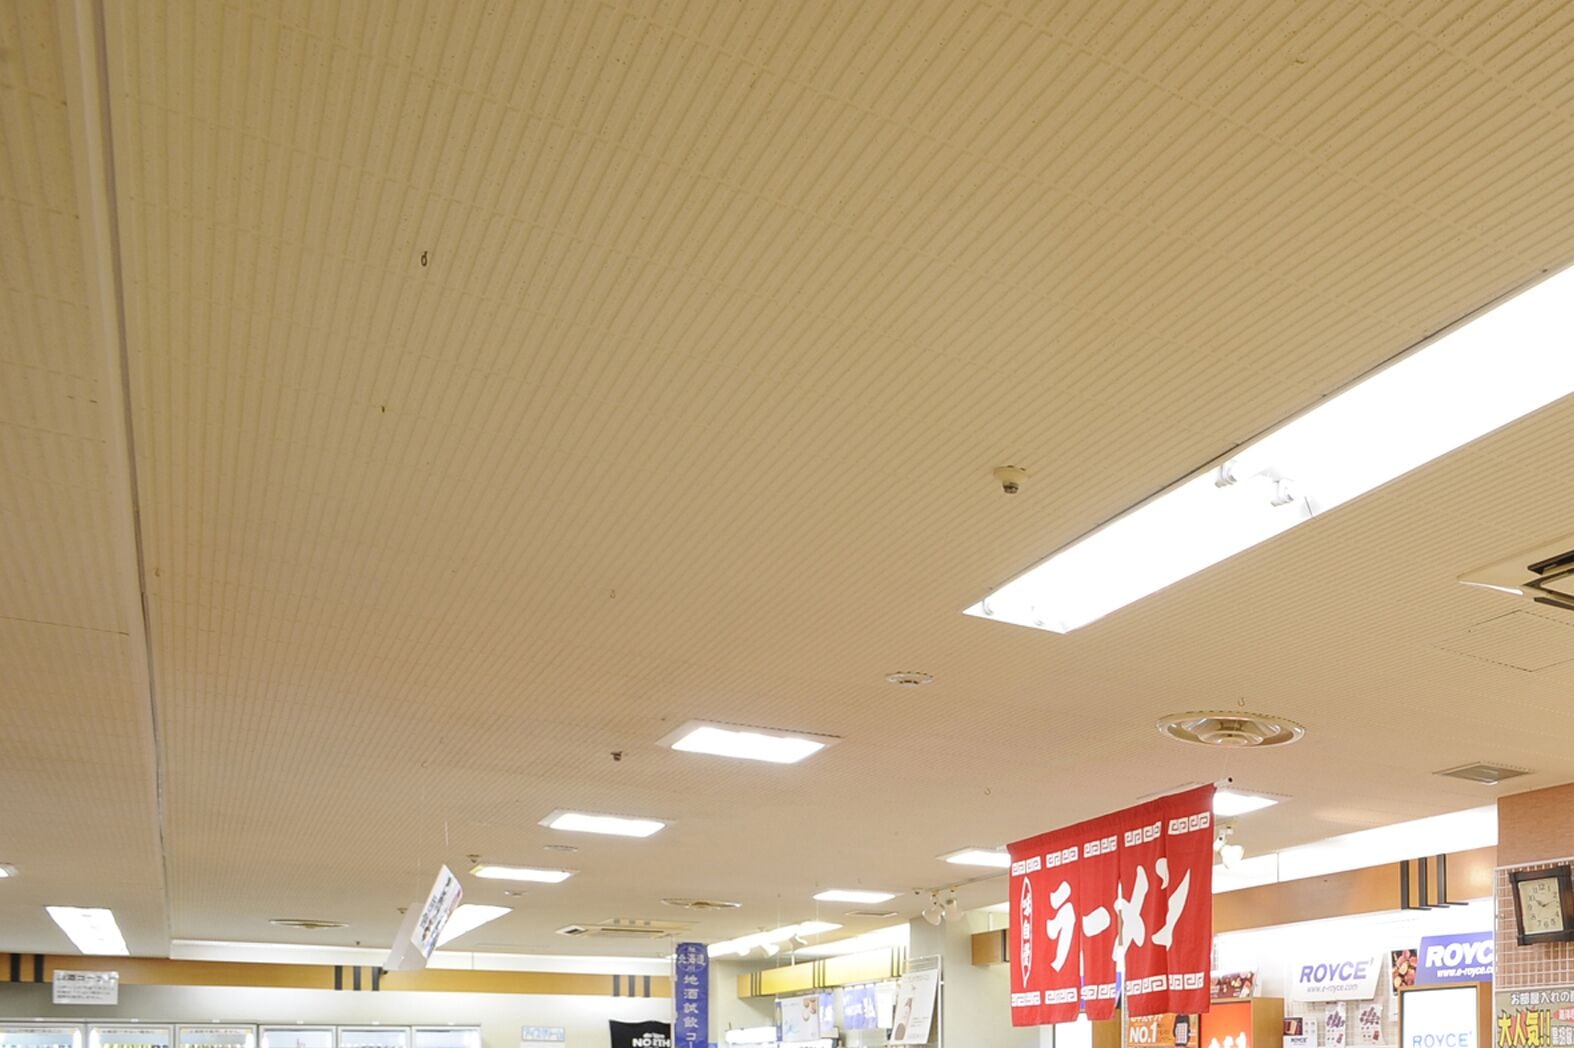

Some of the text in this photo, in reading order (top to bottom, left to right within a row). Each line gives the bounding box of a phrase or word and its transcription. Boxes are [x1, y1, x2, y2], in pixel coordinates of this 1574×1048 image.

[1047, 857, 1190, 972] ラーメン
[1300, 957, 1374, 983] ROYCE'
[1130, 1022, 1157, 1043] NO.1
[1413, 1031, 1472, 1048] ROYCE'
